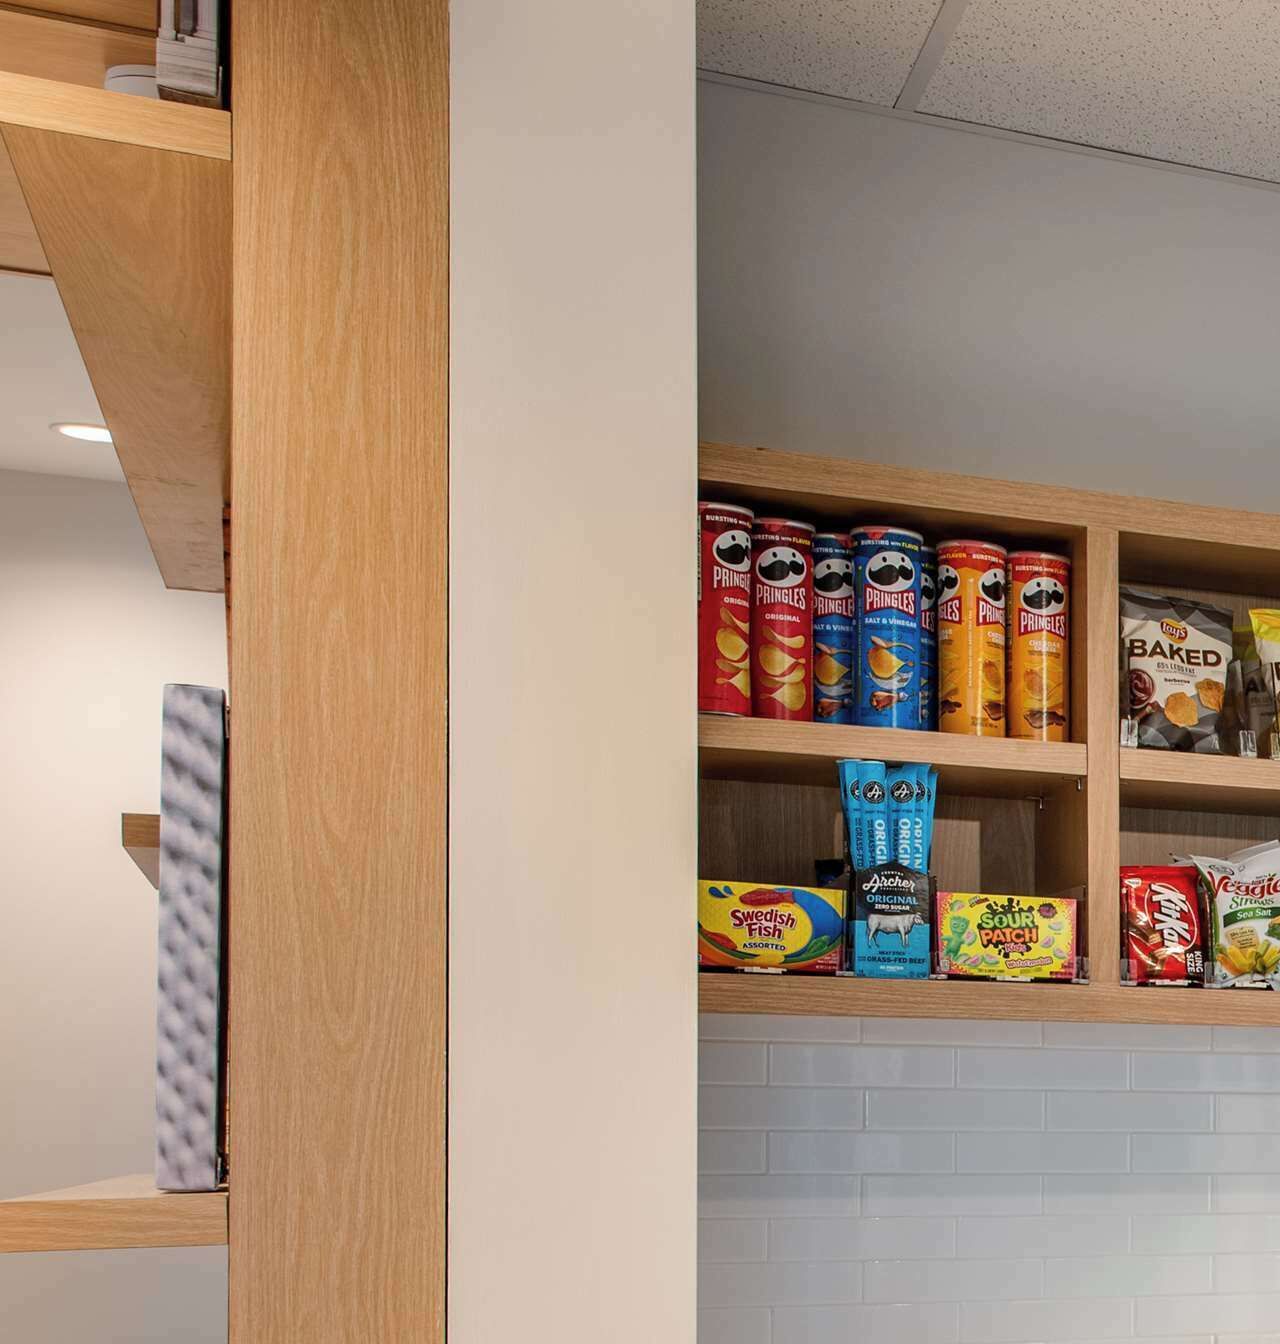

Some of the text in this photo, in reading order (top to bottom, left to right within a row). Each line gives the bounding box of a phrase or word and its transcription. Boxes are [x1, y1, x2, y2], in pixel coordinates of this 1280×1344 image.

[713, 565, 750, 592] PRINGL
[756, 583, 806, 610] PRINGLES
[865, 587, 915, 615] PRINGLES
[765, 613, 801, 622] ORIGINAL
[1021, 611, 1065, 636] PRINGLES
[1129, 638, 1222, 668] BAKED
[862, 873, 916, 893] Archer
[867, 895, 918, 904] ORIGINAL
[730, 909, 797, 929] Swedish
[981, 912, 1035, 929] SOUR
[1236, 908, 1272, 920] Sea Salt
[745, 922, 784, 940] Fish
[980, 927, 1038, 945] PATCH
[743, 942, 786, 951] ASSORTED
[1186, 953, 1195, 973] SIZE
[1194, 951, 1203, 973] KING
